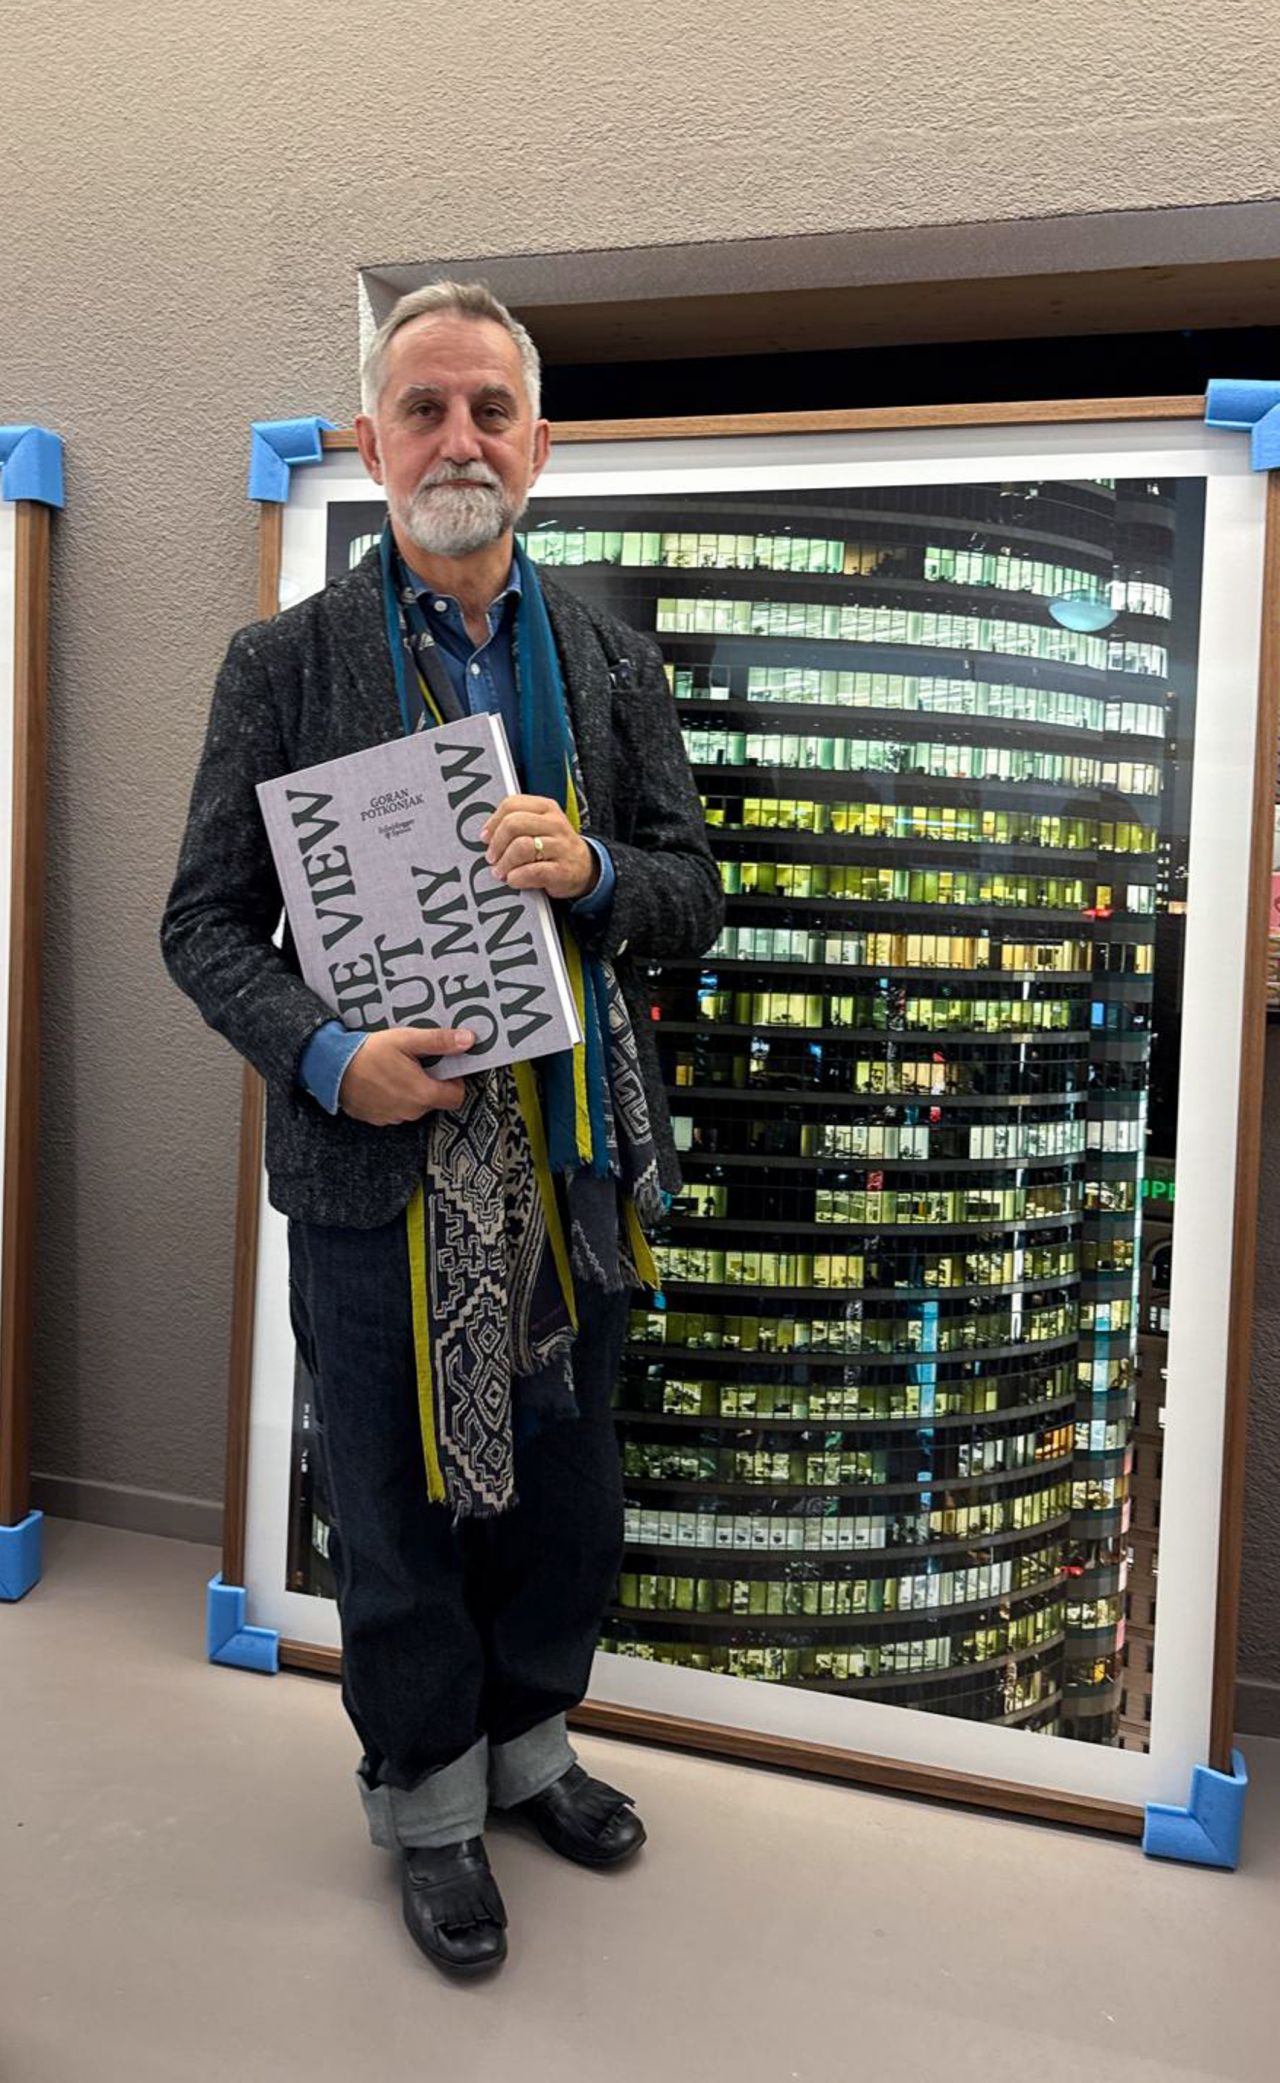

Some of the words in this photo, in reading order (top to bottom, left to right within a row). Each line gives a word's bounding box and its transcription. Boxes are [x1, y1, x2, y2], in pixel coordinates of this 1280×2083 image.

[360, 794, 424, 821] POTKONJAK
[370, 788, 408, 808] GORAN
[286, 789, 364, 951] VIEW
[435, 743, 552, 1049] WINDOW
[411, 866, 479, 960] MY
[329, 953, 389, 1032] HE
[438, 974, 499, 1056] OF
